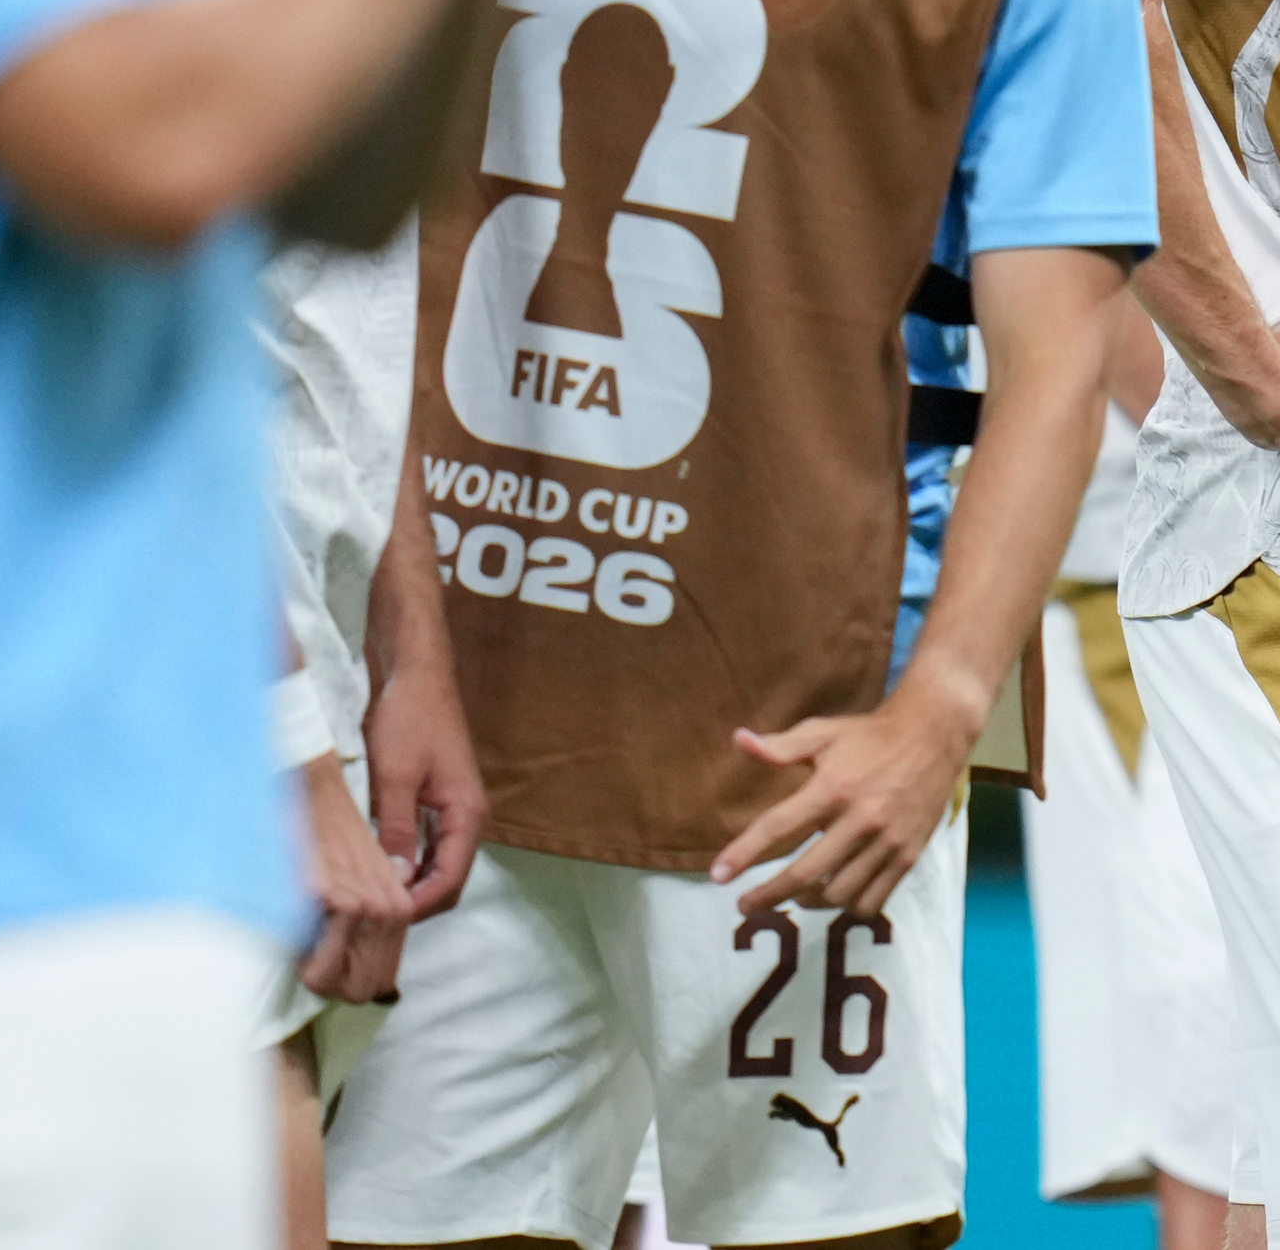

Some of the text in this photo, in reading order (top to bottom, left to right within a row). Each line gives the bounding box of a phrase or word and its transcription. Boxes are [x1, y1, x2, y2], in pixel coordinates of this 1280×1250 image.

[510, 348, 623, 420] FIFA
[422, 454, 690, 544] WORLD CUP
[728, 910, 893, 1079] 26
